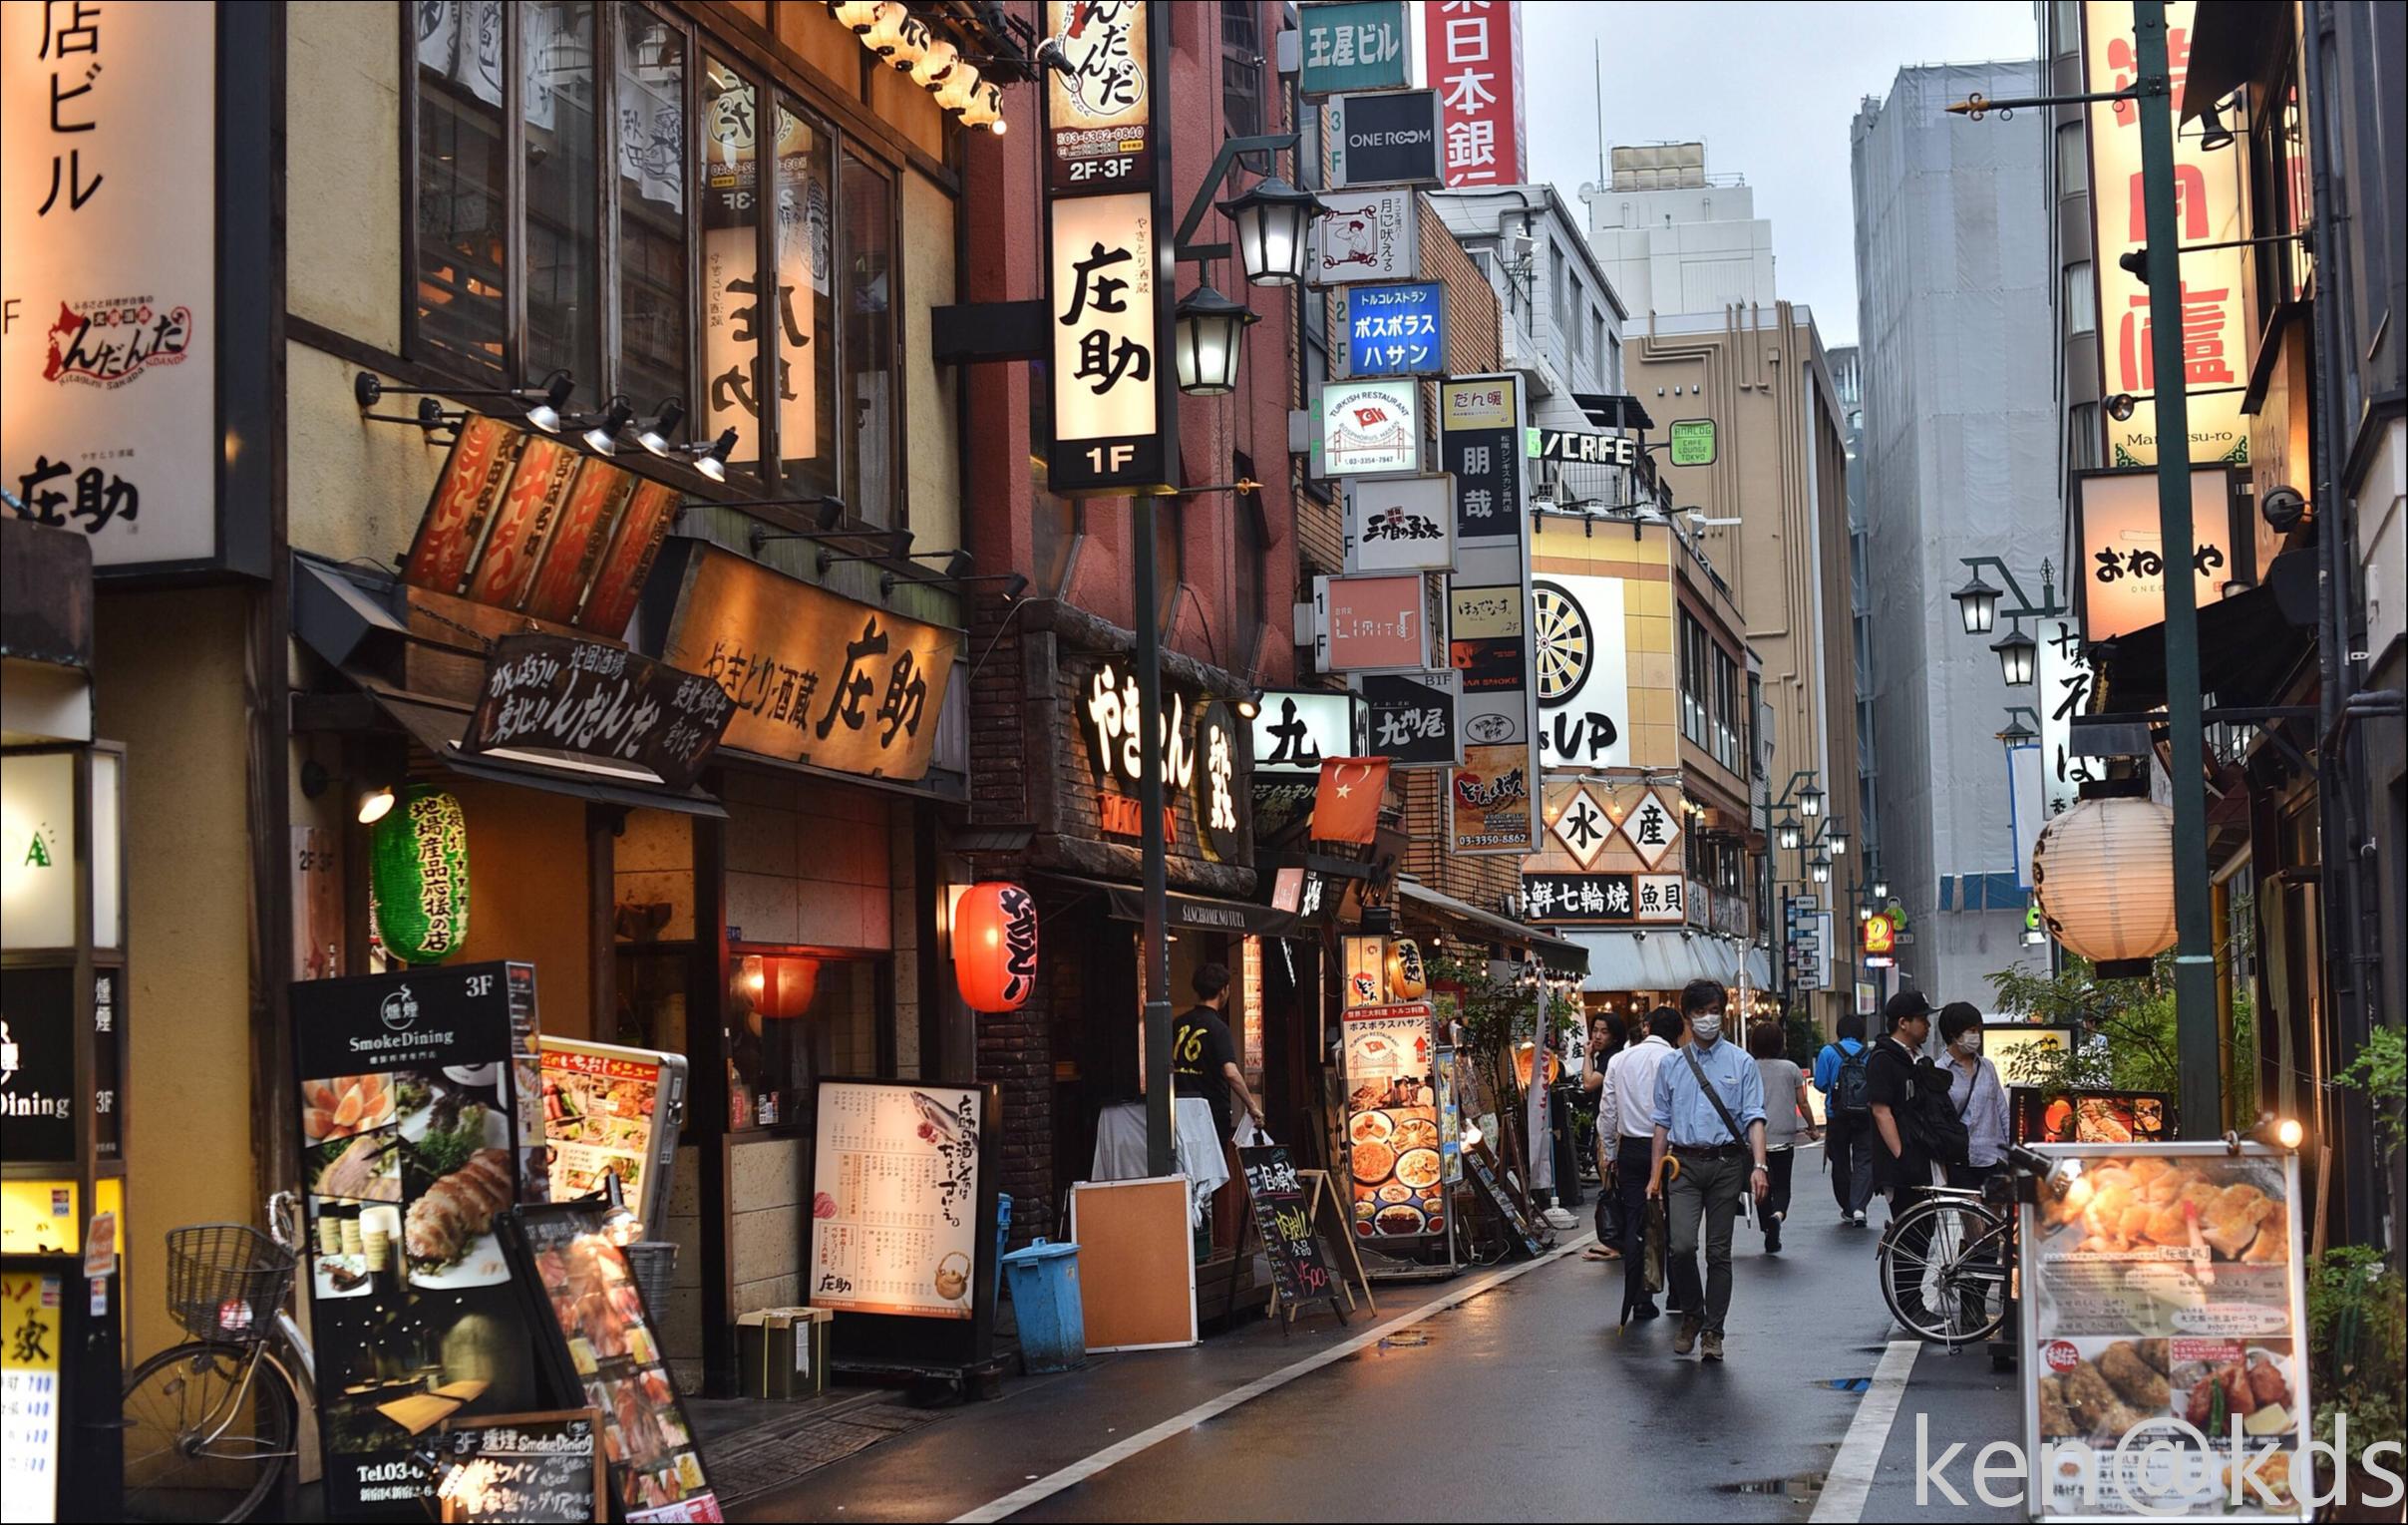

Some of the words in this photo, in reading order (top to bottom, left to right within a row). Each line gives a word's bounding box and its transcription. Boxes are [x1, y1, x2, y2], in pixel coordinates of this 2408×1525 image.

[1308, 23, 1400, 68] 玉屋ビル
[1444, 0, 1497, 188] 日本銀
[1349, 133, 1383, 148] ONE
[1386, 129, 1432, 146] ROOM
[1380, 198, 1395, 272] 月に吠える
[1361, 291, 1428, 306] トルコレストラン
[1059, 240, 1151, 395] 庄助
[62, 313, 183, 378] んだんだ
[1363, 345, 1428, 367] ハサン
[1329, 393, 1360, 417] TURKISH
[1362, 390, 1410, 417] RESTAURANT
[1453, 390, 1503, 408] だん暖
[1085, 445, 1135, 474] 1F
[18, 455, 140, 535] 庄助
[2094, 545, 2225, 582] おねや
[815, 614, 929, 751] 庄助
[1425, 675, 1453, 687] B1F
[1265, 696, 1322, 769] 九
[1376, 707, 1446, 748] 九州屋
[1553, 711, 1618, 762] UP
[1459, 834, 1528, 846] 03-3350-8862
[409, 798, 451, 952] 地場産品応援の店
[1639, 882, 1683, 914] 魚貝
[465, 973, 495, 998] 3F
[349, 1029, 456, 1052] SmokeDining
[1173, 1024, 1208, 1063] 16
[96, 1090, 114, 1113] 3F
[818, 1273, 853, 1295] 庄助
